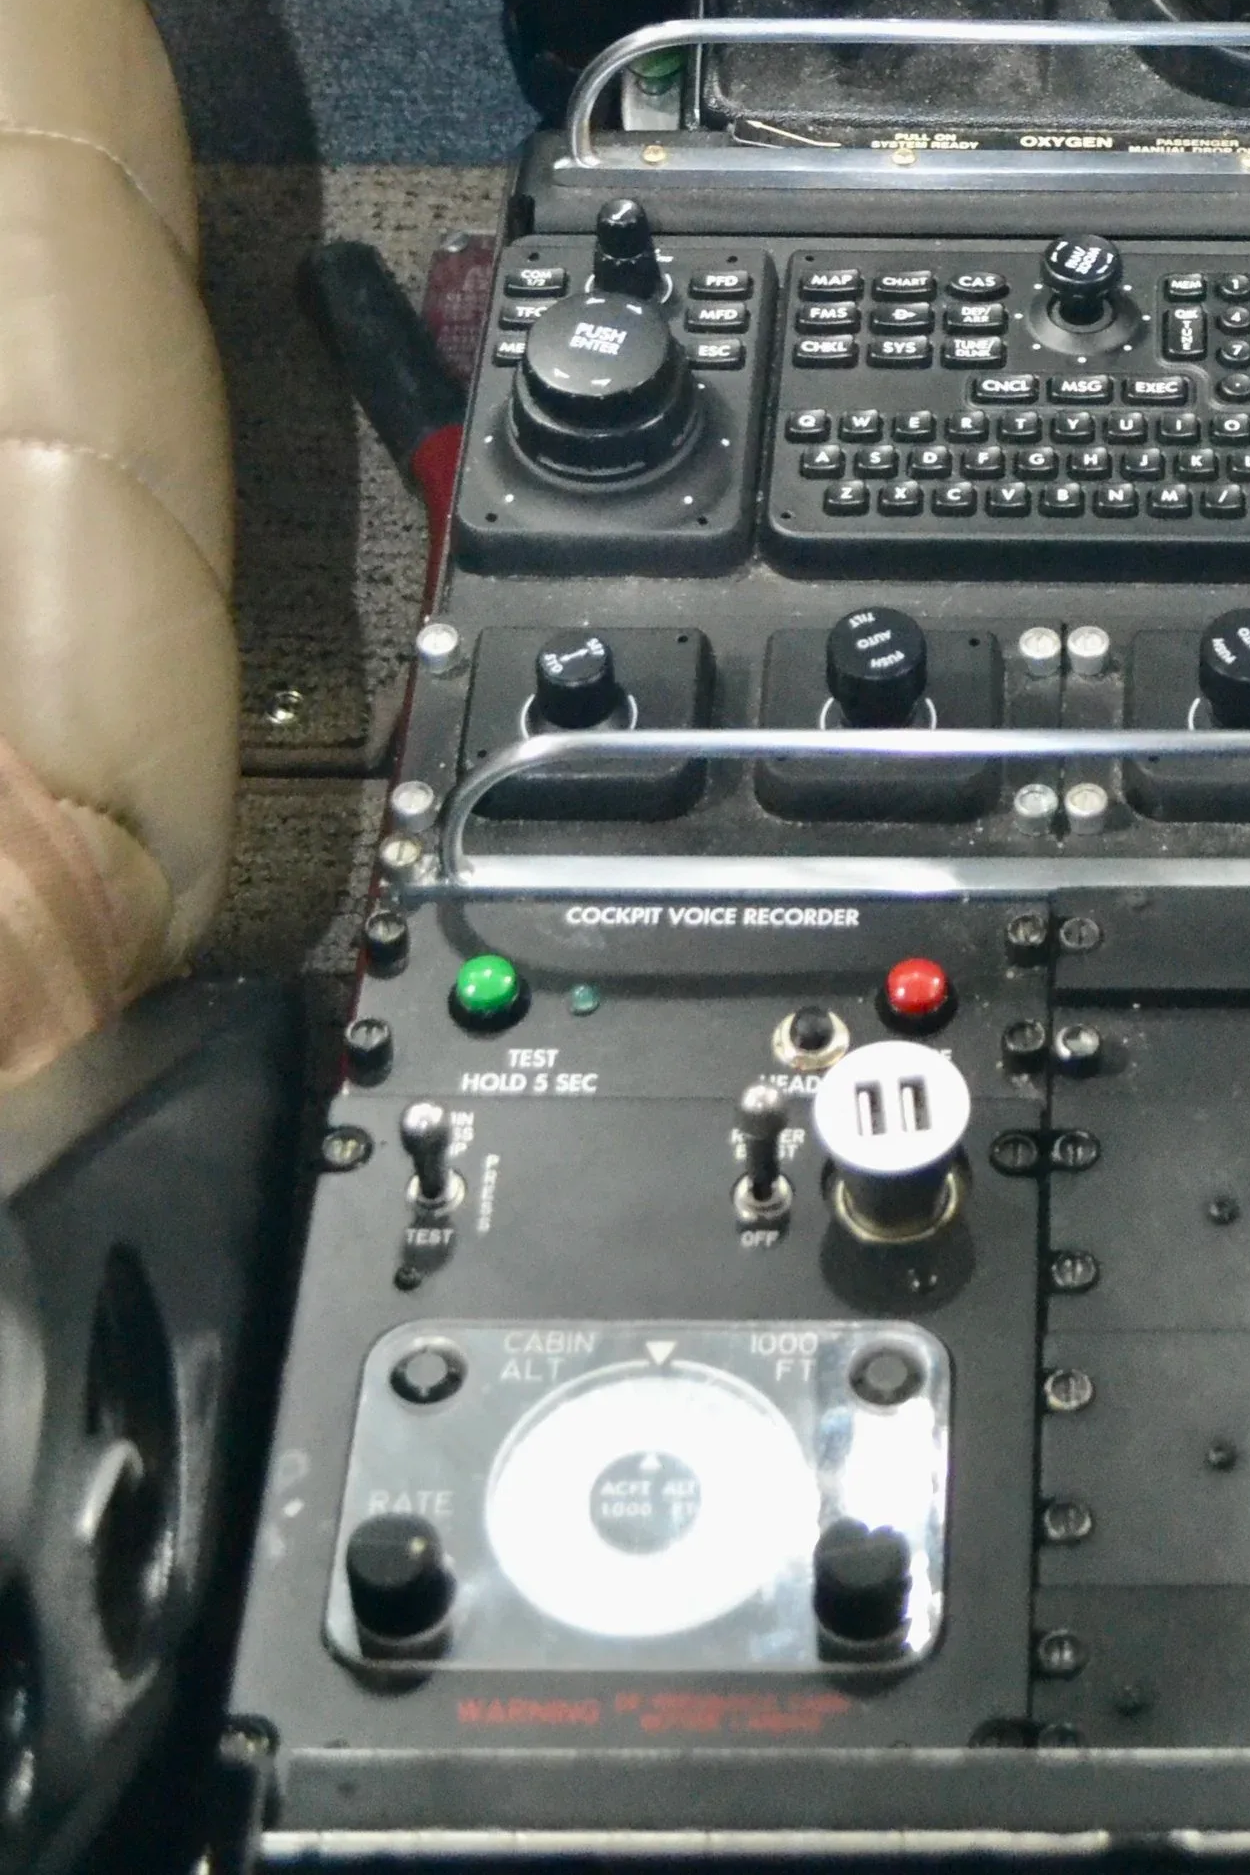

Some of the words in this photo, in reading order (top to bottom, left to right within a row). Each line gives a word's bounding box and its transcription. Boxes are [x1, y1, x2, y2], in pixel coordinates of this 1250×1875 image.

[1020, 136, 1113, 149] OXYGEN
[1155, 138, 1239, 147] PASSENGER
[706, 276, 739, 286] PFD
[811, 275, 852, 286] MAP
[882, 277, 928, 286] CHART
[958, 276, 995, 287] CAS
[700, 309, 738, 320] MFD
[810, 308, 848, 319] FMS
[577, 323, 627, 342] PUSH
[570, 336, 620, 355] ENTER
[699, 345, 731, 356] ESC
[883, 343, 916, 354] SYS
[982, 380, 1030, 392] CNCL
[1061, 381, 1102, 392] MSG
[1135, 382, 1178, 393] EXEC
[566, 906, 663, 926] COCKPIT
[670, 907, 739, 926] VOICE
[744, 908, 859, 927] RECORDER
[508, 1049, 558, 1067] TEST
[461, 1074, 528, 1093] HOLD
[533, 1074, 548, 1093] 5
[556, 1074, 598, 1093] SEC
[406, 1229, 454, 1245] TEST
[741, 1230, 778, 1246] OFF
[504, 1333, 595, 1354] CABIN
[750, 1333, 818, 1354] 1000
[501, 1358, 564, 1381] ALT
[775, 1359, 817, 1382] FT
